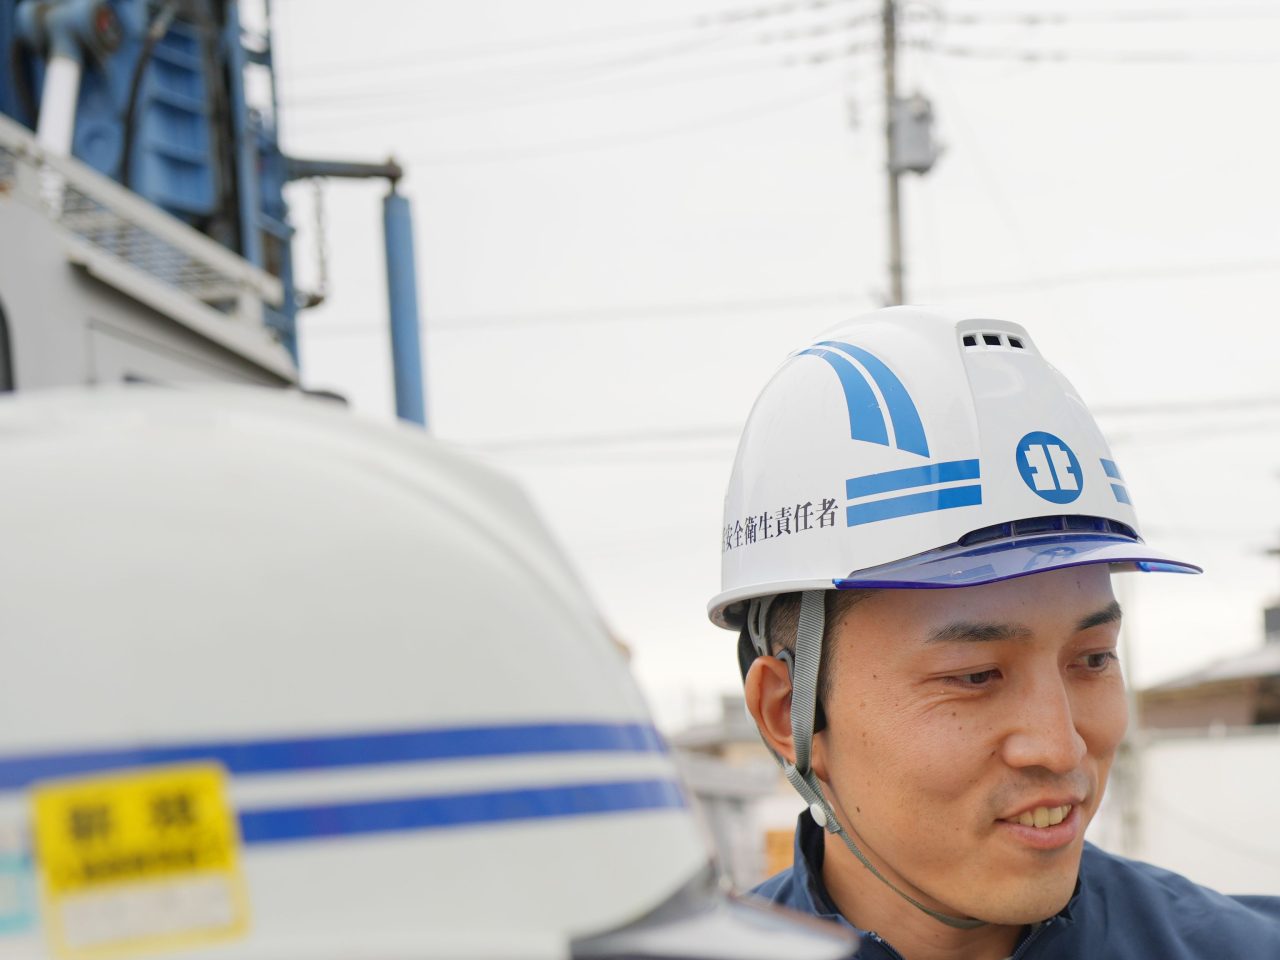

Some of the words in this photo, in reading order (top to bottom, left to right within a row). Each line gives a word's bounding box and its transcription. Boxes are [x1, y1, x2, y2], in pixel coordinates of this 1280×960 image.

[722, 498, 839, 553] 安全衛生責任者
